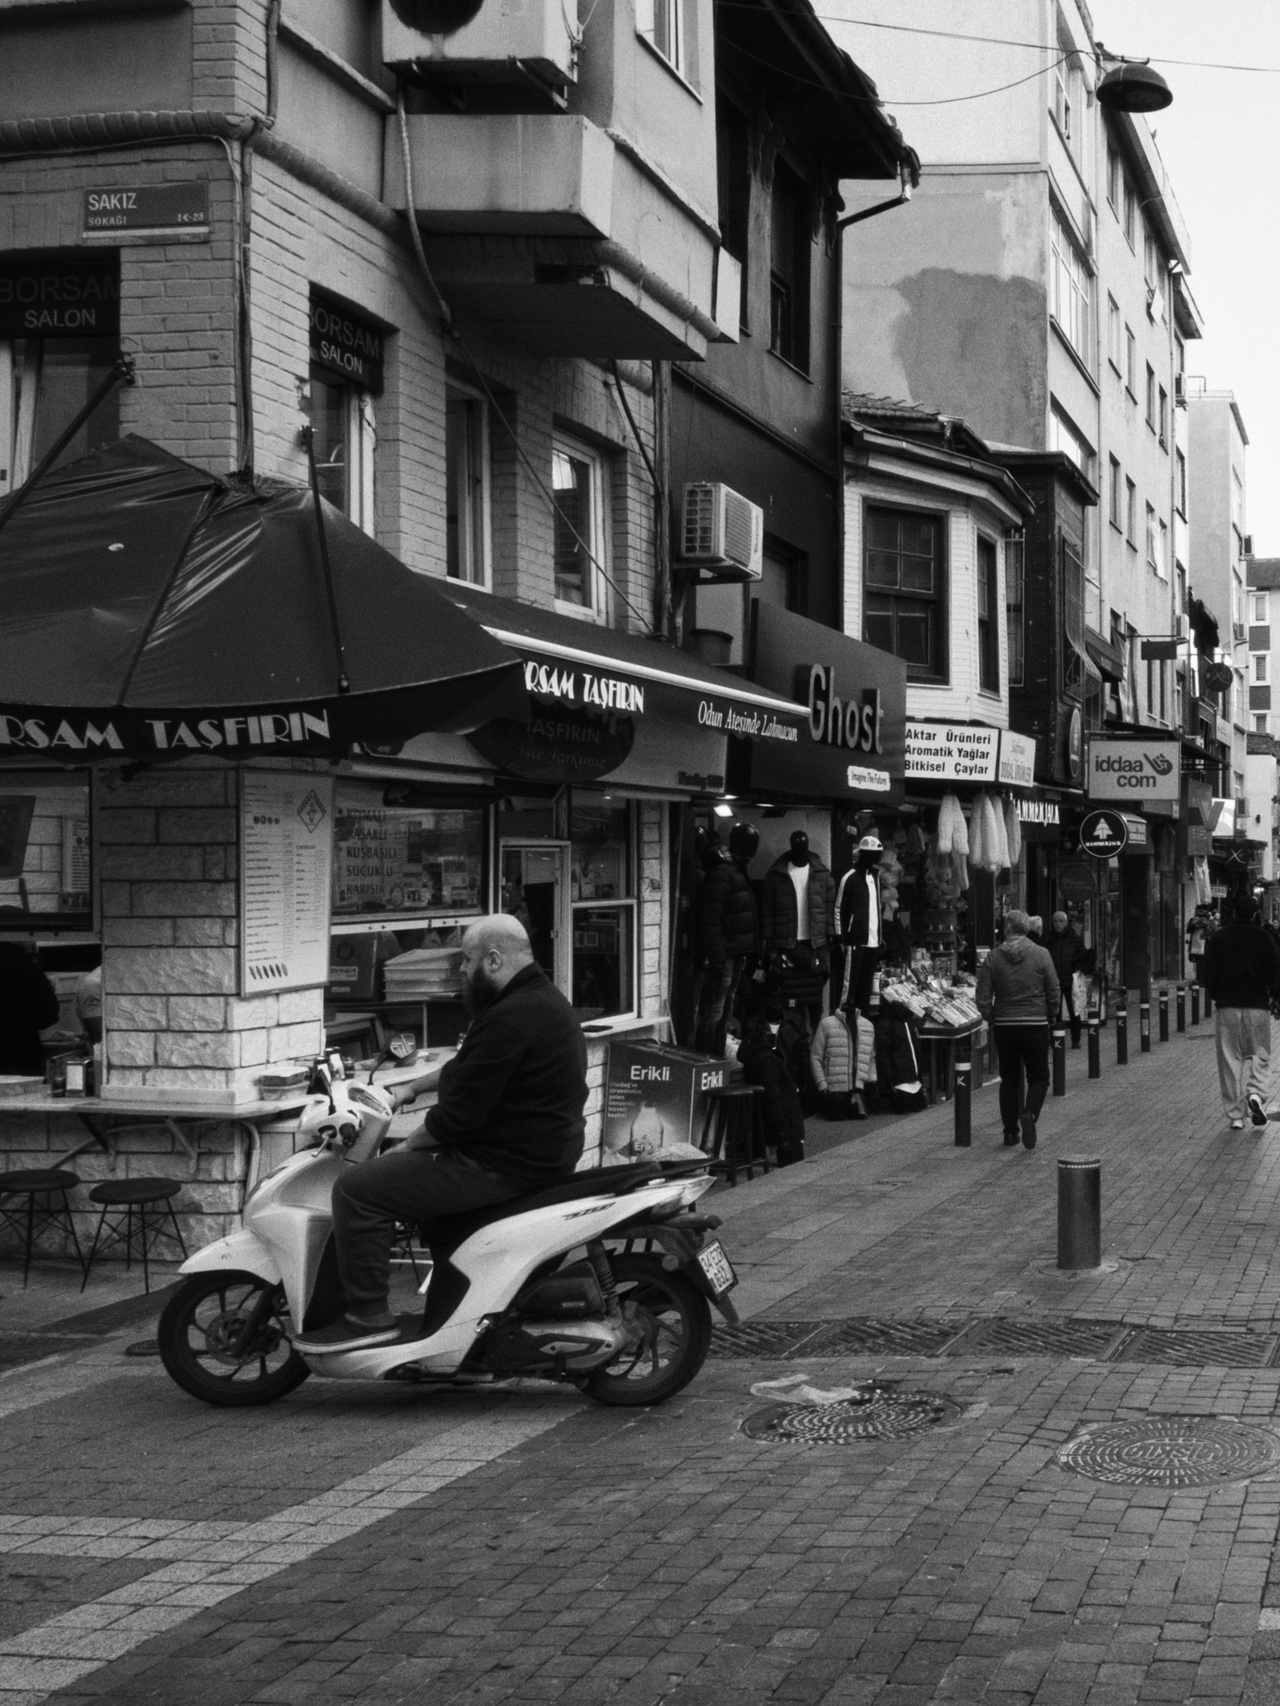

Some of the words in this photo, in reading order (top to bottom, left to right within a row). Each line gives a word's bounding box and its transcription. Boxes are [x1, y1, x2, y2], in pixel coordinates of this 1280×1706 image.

[88, 192, 138, 211] SAKIZ
[88, 215, 127, 226] SOKAĞI
[24, 308, 96, 328] SALON
[320, 340, 362, 375] SALON
[582, 673, 645, 714] TAŞFIRIN
[808, 662, 885, 754] Ghost
[145, 708, 331, 749] TAŞFIRIN
[698, 700, 723, 728] Odun
[724, 706, 761, 734] Ateşinde
[761, 714, 798, 742] Lahmacun
[905, 729, 937, 741] Aktar
[946, 728, 992, 745] Ürünleri
[905, 744, 953, 758] Aromatik
[957, 746, 990, 761] Yağlar
[904, 760, 945, 772] Bitkisel
[954, 762, 989, 776] Çaylar
[1095, 756, 1143, 773] iddaa
[1117, 775, 1157, 788] com
[630, 1065, 670, 1081] Erikli
[701, 1070, 723, 1091] Erikli
